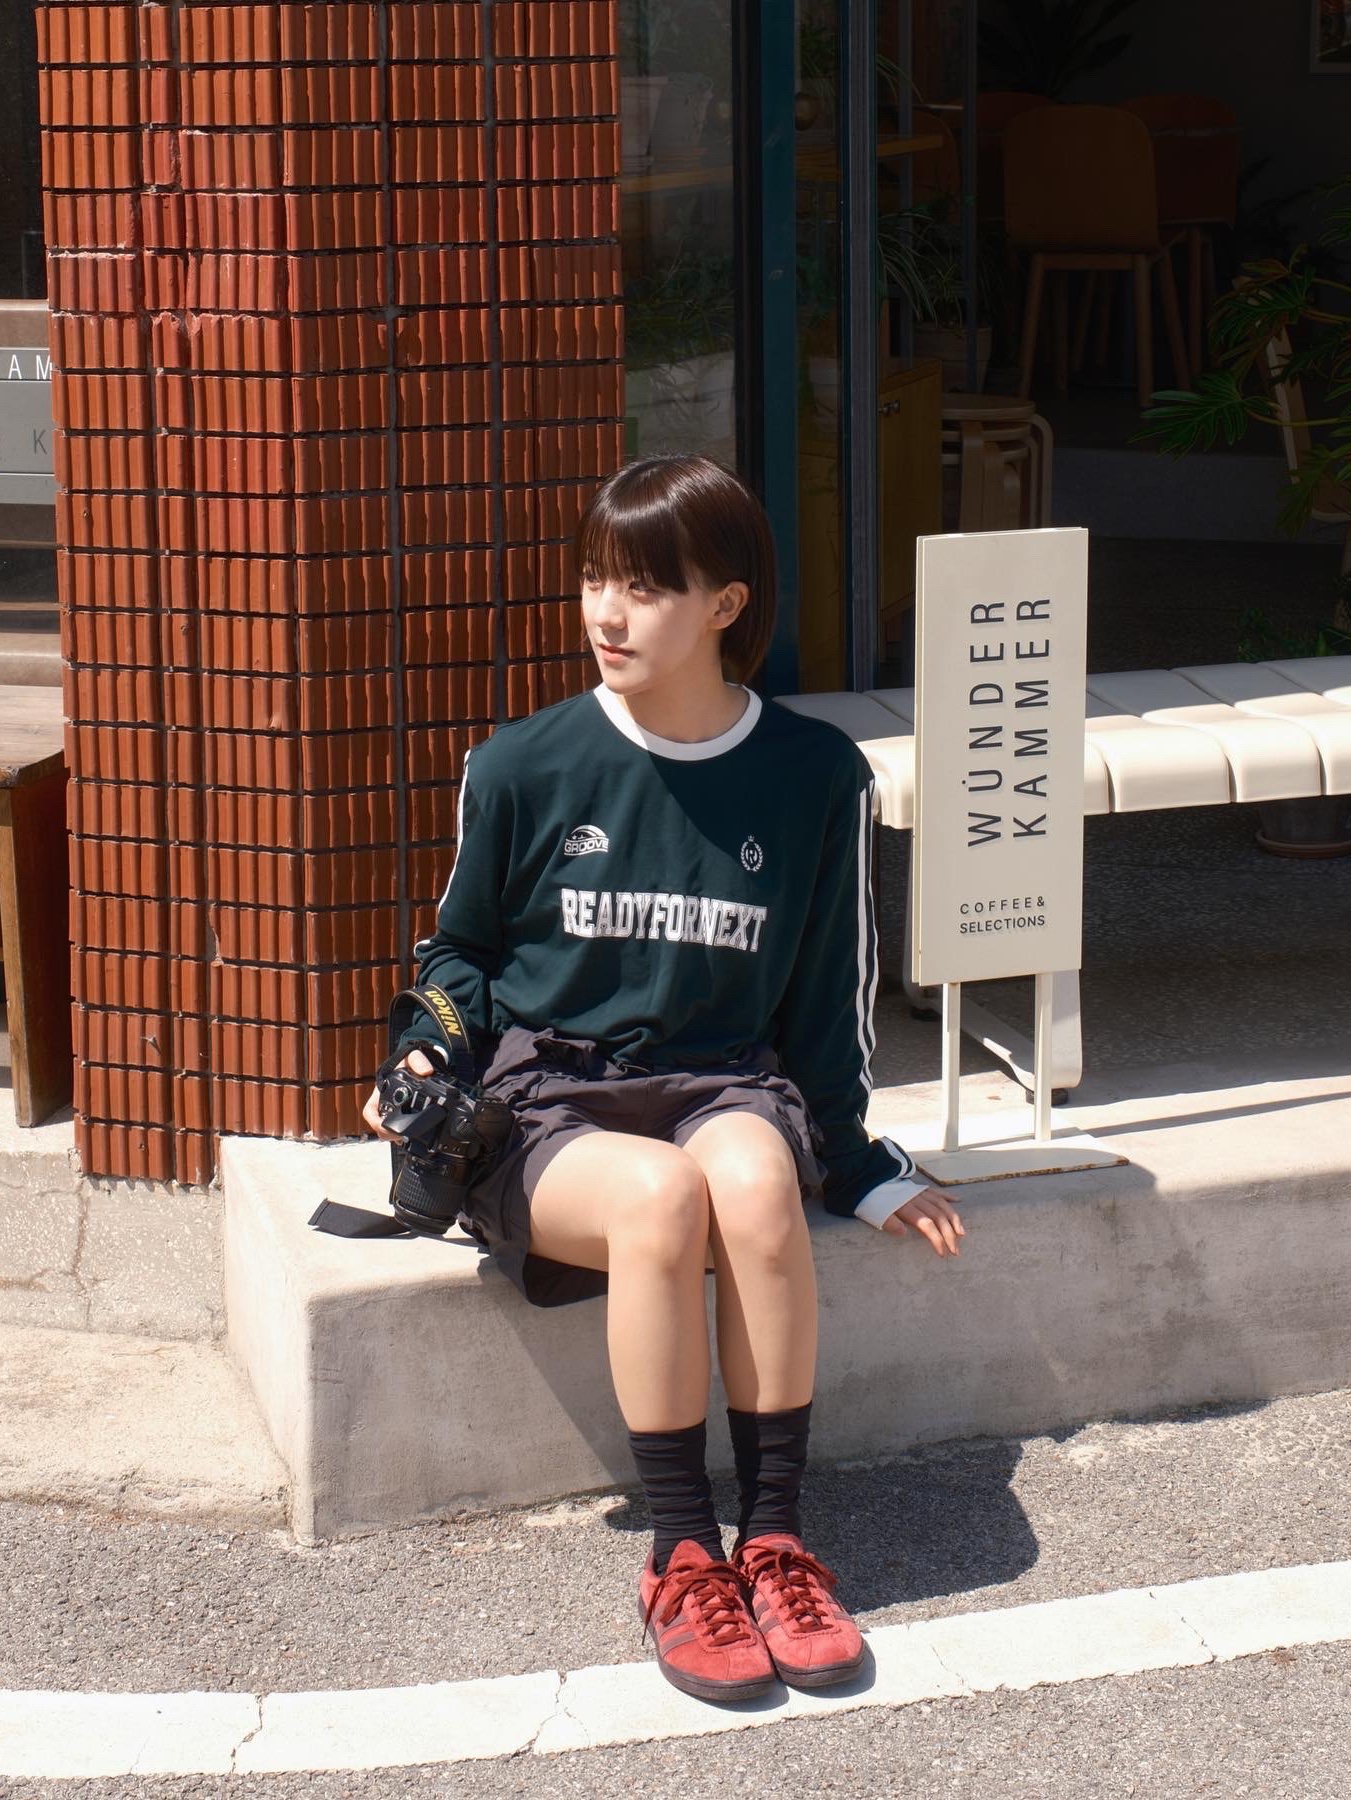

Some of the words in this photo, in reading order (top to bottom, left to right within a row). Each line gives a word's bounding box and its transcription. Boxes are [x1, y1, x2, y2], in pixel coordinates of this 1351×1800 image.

[1013, 599, 1051, 838] KAMMER
[564, 839, 609, 853] GROOVE
[561, 888, 767, 952] READYFORNEXT
[960, 915, 1045, 934] SELECTIONS
